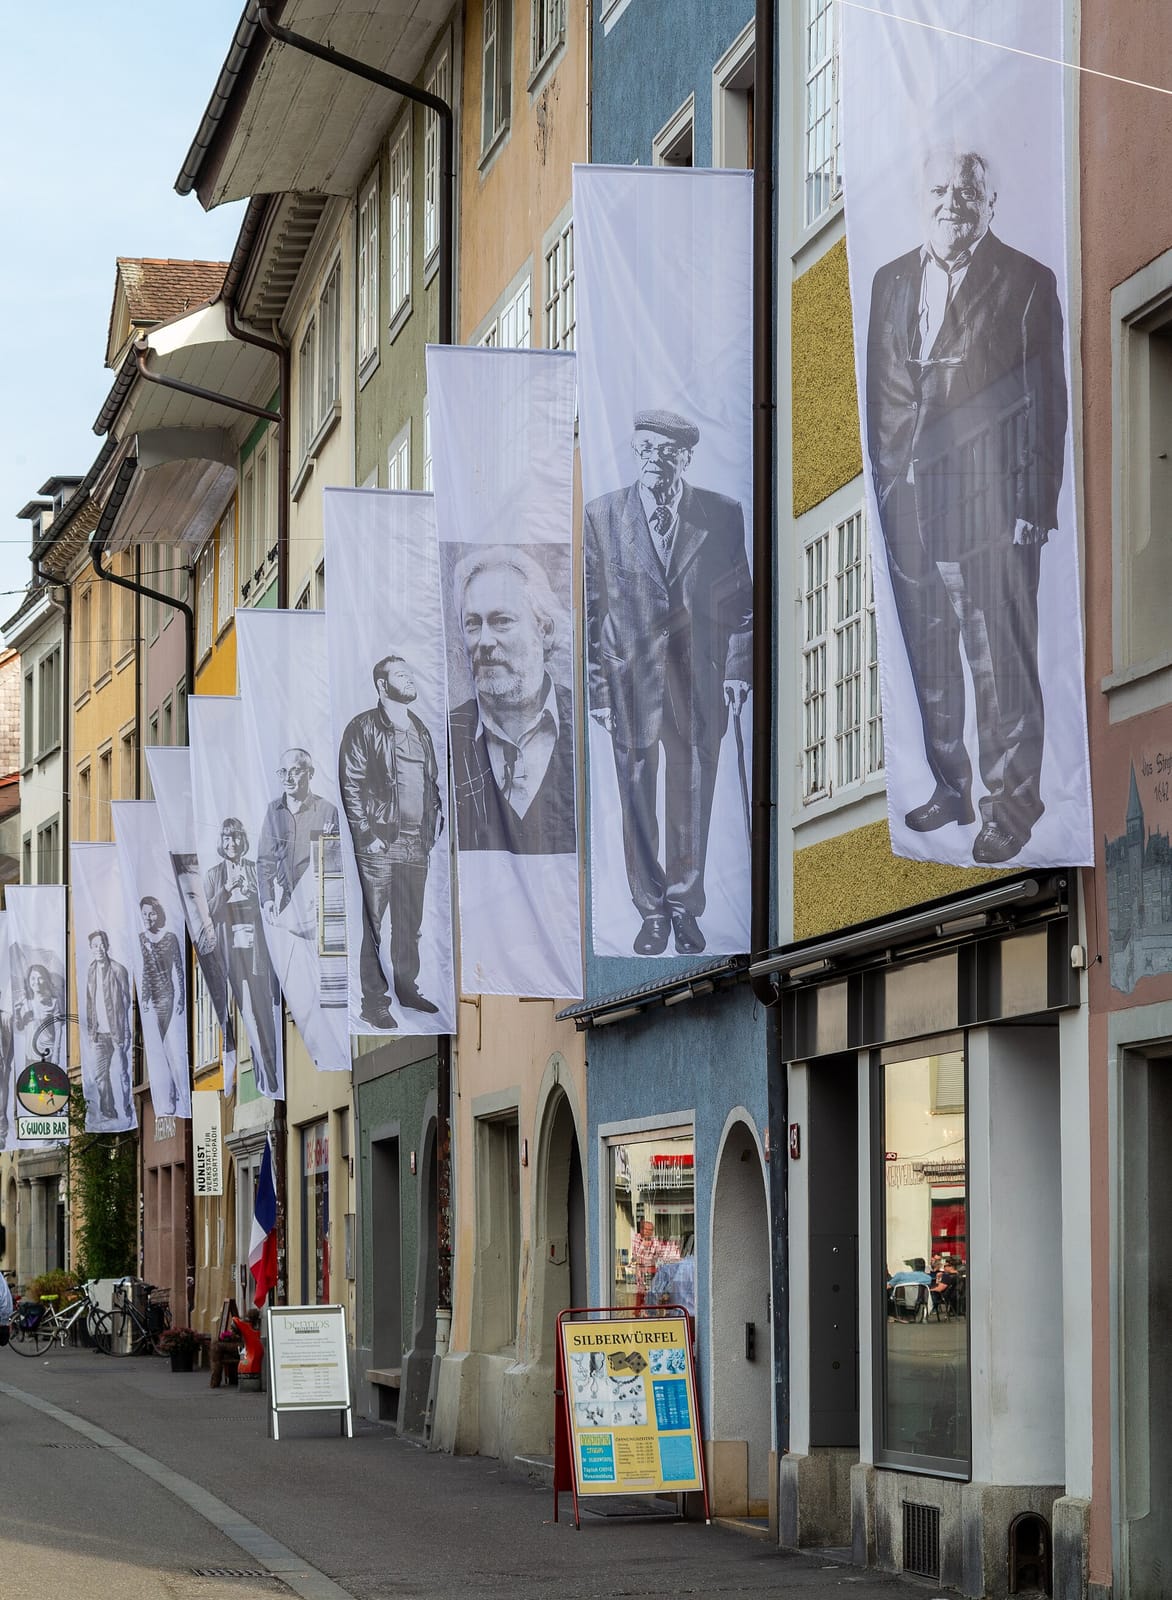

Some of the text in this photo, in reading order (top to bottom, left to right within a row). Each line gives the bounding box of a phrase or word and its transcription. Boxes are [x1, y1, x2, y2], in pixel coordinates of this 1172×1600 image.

[53, 1121, 67, 1135] BAR
[196, 1145, 206, 1192] NÜNLIST
[573, 1331, 678, 1346] SILBERWÜRFEL
